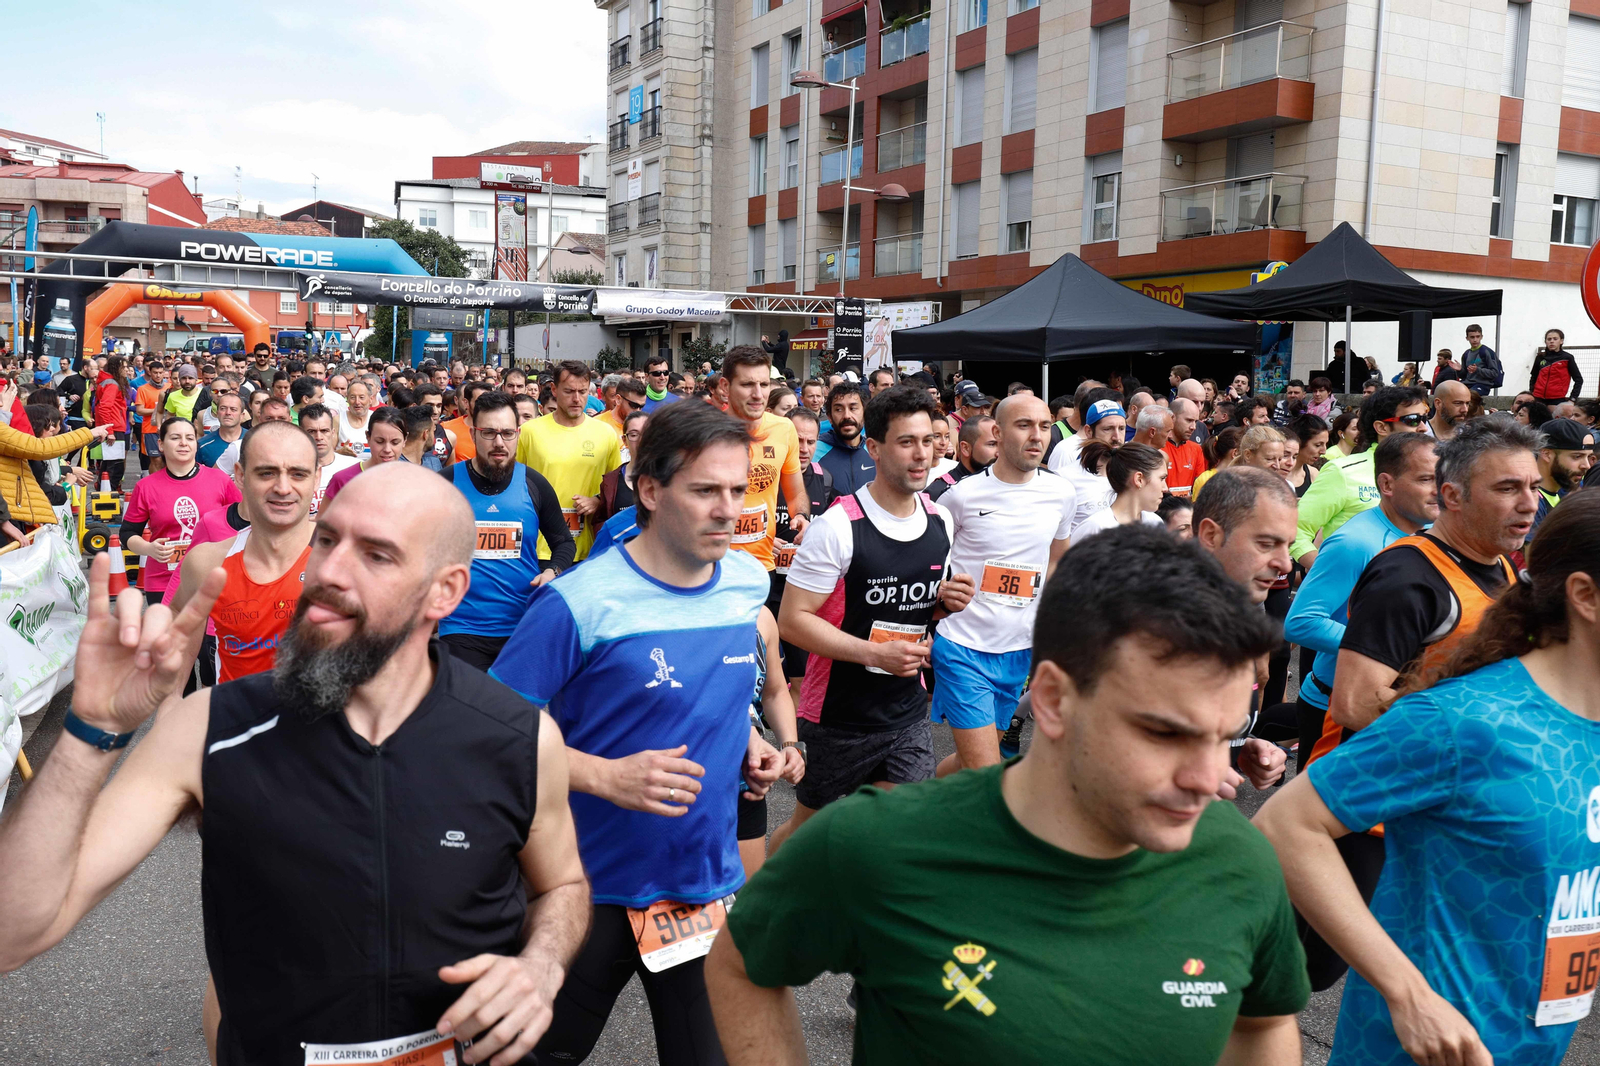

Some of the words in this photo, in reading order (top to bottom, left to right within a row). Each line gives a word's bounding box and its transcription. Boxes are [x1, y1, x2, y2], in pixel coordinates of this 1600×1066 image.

[631, 94, 641, 115] 19
[482, 163, 526, 172] RESTAURANTE
[181, 241, 334, 267] POWERADE
[381, 278, 440, 294] Concello
[444, 281, 463, 295] do
[466, 282, 522, 298] Porriño
[404, 294, 411, 302] O
[413, 294, 448, 304] Concello
[450, 296, 460, 305] do
[462, 297, 494, 307] Deporte
[558, 294, 579, 302] Concello
[558, 302, 589, 310] Porriño
[625, 304, 654, 315] Grupo
[655, 306, 685, 317] Godoy
[686, 307, 721, 316] Maceira
[44, 331, 77, 340] POWERADE
[792, 341, 809, 350] Carril
[809, 341, 819, 349] 32
[479, 532, 506, 549] 700
[998, 574, 1021, 595] 36
[723, 655, 750, 664] Gestamp
[440, 839, 470, 850] Kalenji
[652, 904, 713, 945] 963
[1564, 922, 1595, 934] CARREIRA
[1162, 981, 1228, 995] GUARDIA
[1180, 995, 1217, 1008] CIVIL
[313, 1050, 330, 1060] XIII
[333, 1050, 378, 1060] CARREIRA
[382, 1048, 394, 1057] DE
[396, 1045, 404, 1053] O
